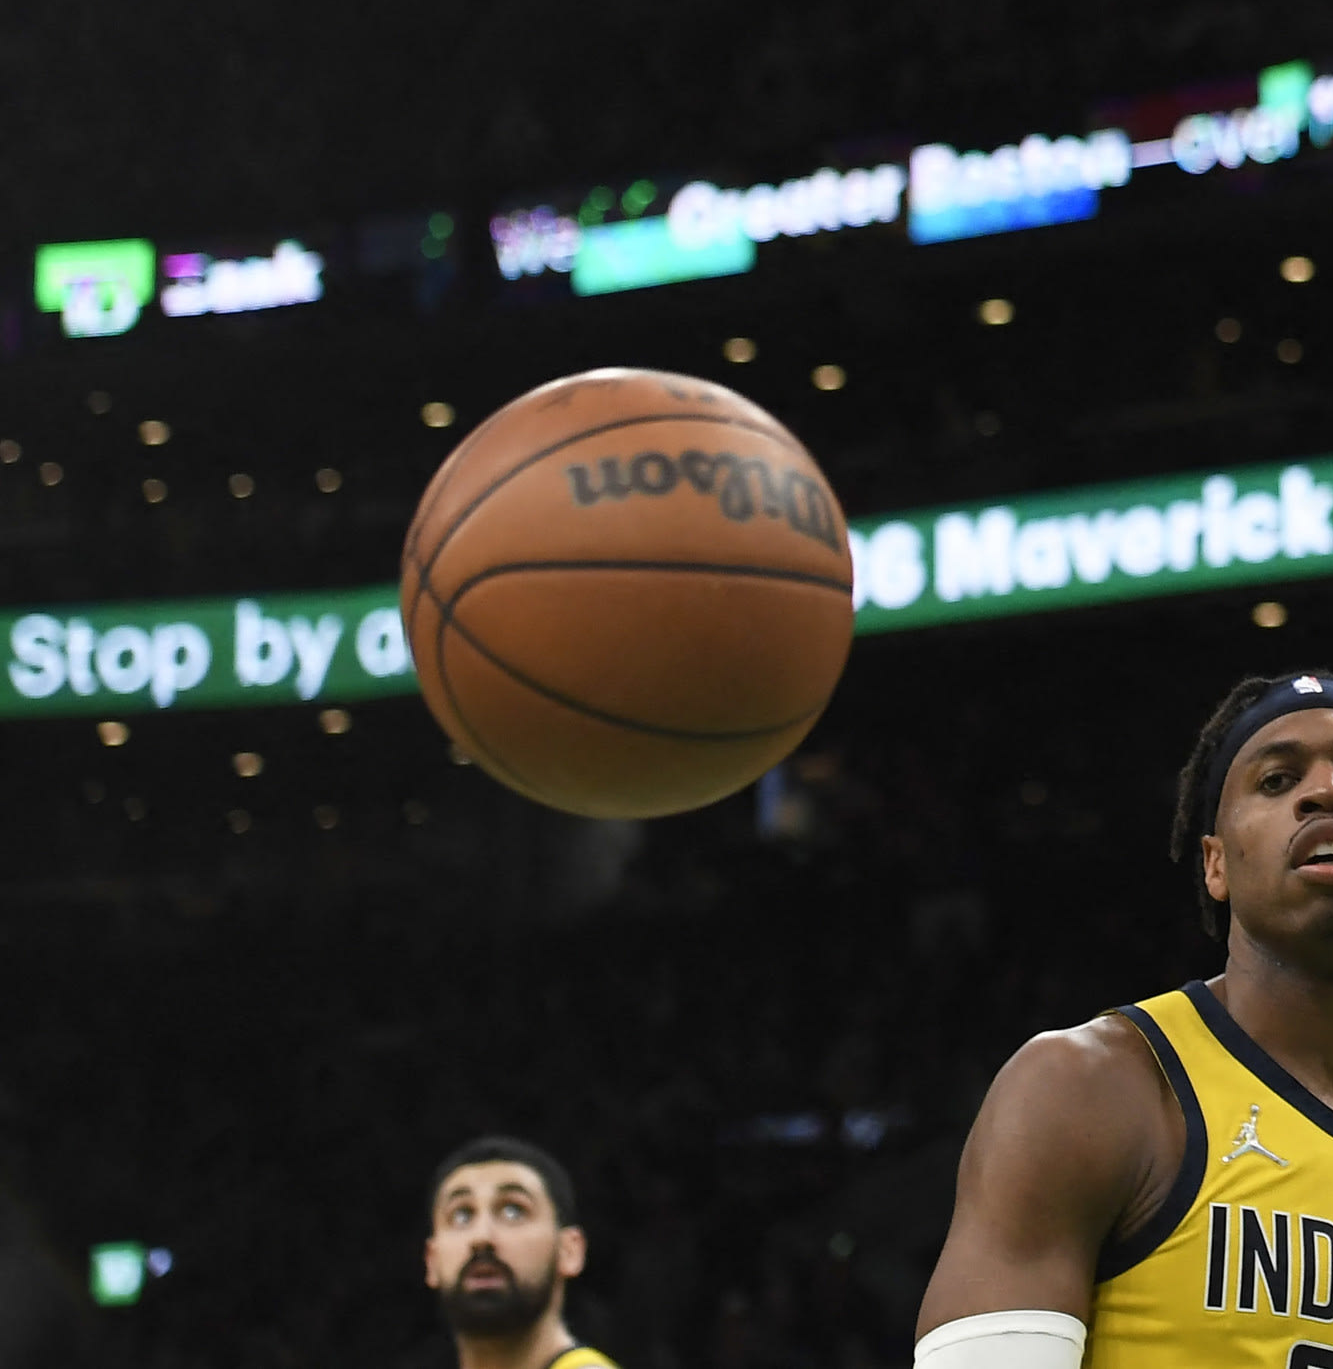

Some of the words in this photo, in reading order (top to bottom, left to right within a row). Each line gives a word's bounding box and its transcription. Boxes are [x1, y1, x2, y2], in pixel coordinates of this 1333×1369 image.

[566, 447, 842, 555] Wilson
[7, 611, 211, 708] Stop
[233, 597, 344, 701] by
